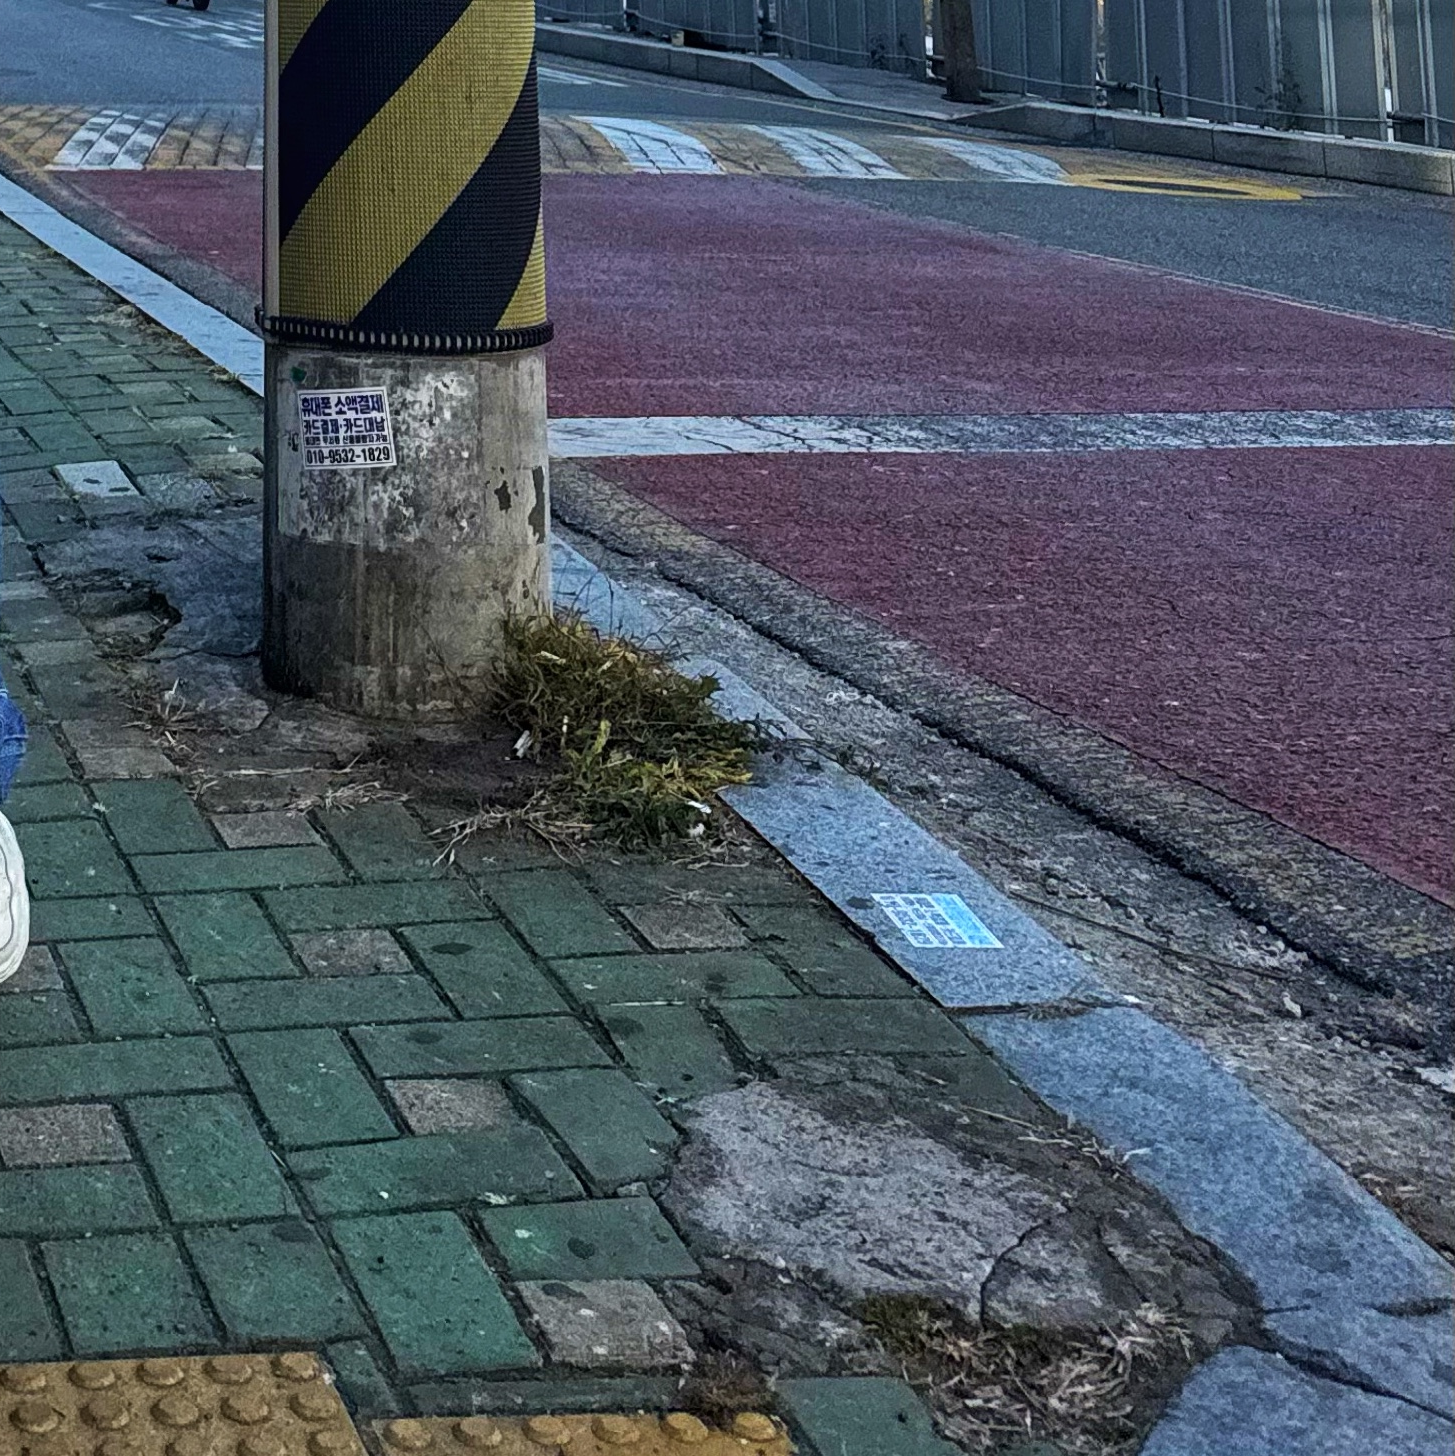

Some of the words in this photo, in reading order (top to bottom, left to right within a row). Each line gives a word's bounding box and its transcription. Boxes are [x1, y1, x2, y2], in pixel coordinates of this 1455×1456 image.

[301, 397, 333, 417] 휴대폰
[334, 394, 385, 415] 소액결제
[306, 446, 390, 464] 010-9532-1829
